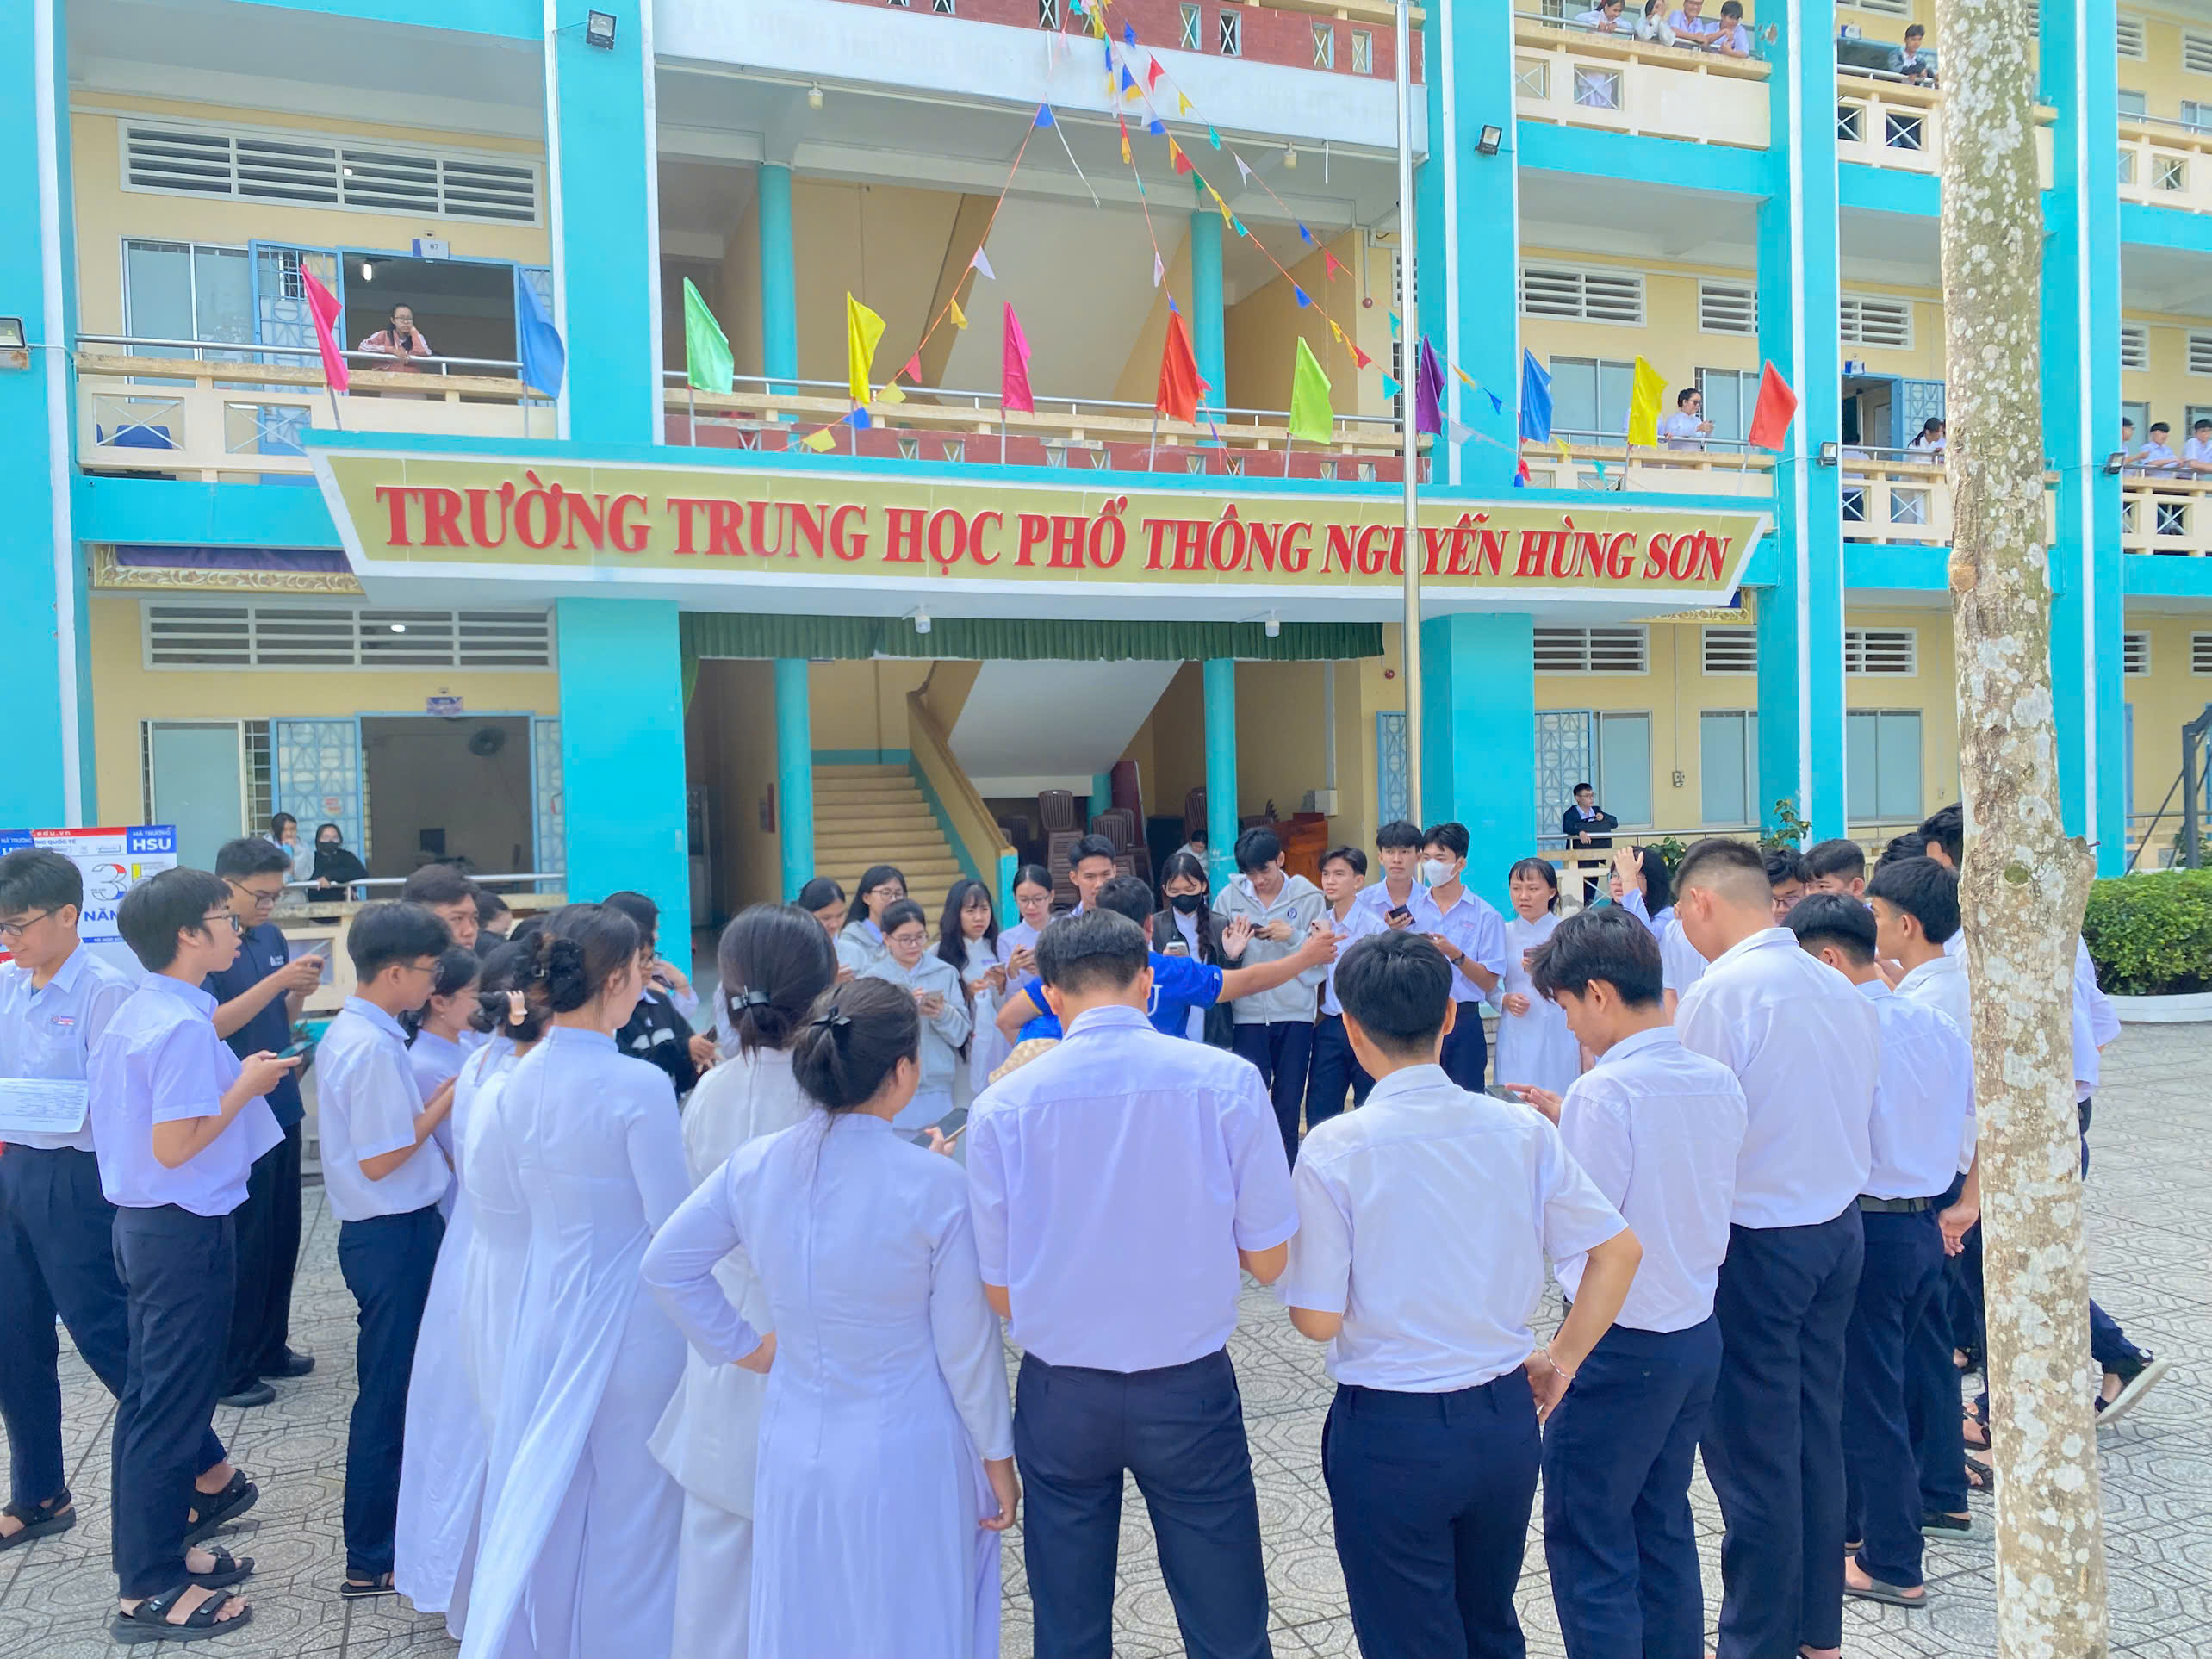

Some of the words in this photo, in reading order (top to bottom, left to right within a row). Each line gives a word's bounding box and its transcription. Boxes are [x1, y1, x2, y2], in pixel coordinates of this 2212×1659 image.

[375, 469, 651, 552] TRƯỜNG
[666, 499, 868, 563] TRUNG
[882, 507, 1003, 576] HỌC
[1014, 495, 1127, 569] PHỔ
[1142, 503, 1312, 573] THÔNG
[1513, 516, 1638, 580] HÙNG
[1643, 527, 1734, 581] SƠN
[133, 838, 171, 851] HSU
